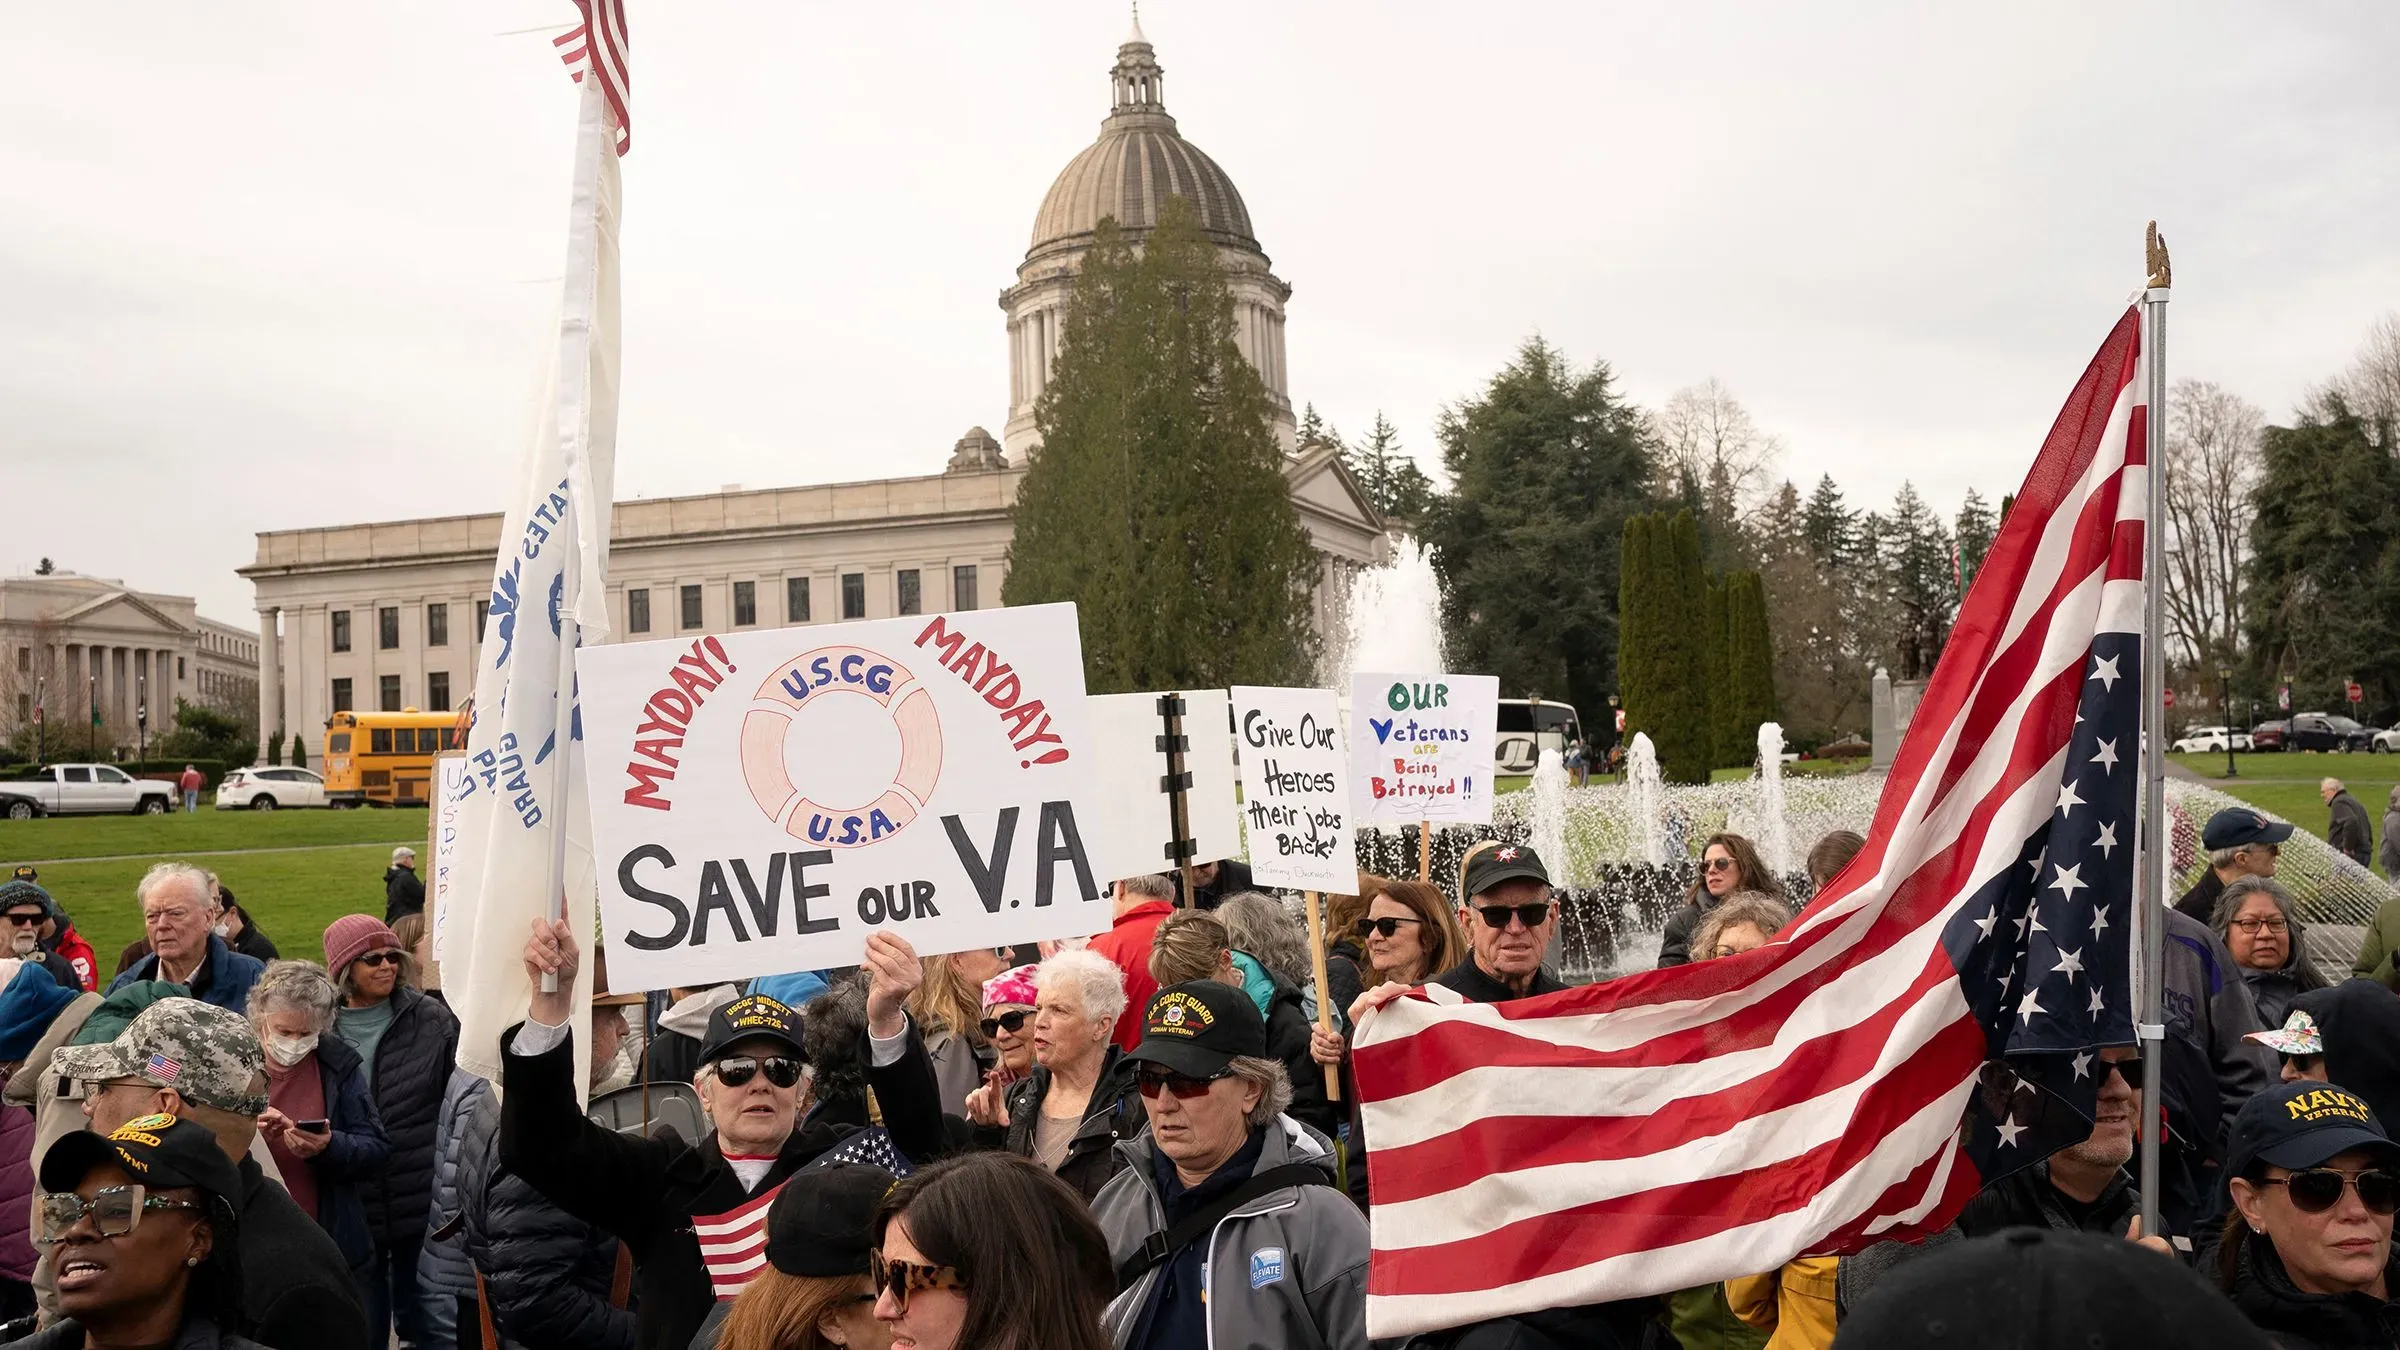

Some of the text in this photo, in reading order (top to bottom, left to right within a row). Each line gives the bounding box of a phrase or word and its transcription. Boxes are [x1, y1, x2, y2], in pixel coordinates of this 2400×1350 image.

[913, 615, 1070, 770] MAYDAY!
[1387, 681, 1449, 712] OUR
[624, 635, 737, 811] MAYDAY!
[1243, 708, 1337, 752] Give Our
[1369, 717, 1470, 745] Veterans
[1413, 742, 1438, 756] are
[1264, 758, 1336, 797] Heroes
[1394, 758, 1438, 778] Being
[1371, 776, 1456, 801] Betrayed
[807, 808, 902, 845] U.S.A.
[1248, 800, 1342, 843] their jobs
[1275, 832, 1337, 860] BACK!
[617, 800, 1111, 951] SAVE OUR V.A.
[726, 995, 792, 1017] USCGC MIDGETT
[1159, 992, 1188, 1007] COAST
[1186, 996, 1214, 1025] GUARD
[739, 1015, 782, 1029] WHEC-726
[1168, 1027, 1194, 1036] VETERAN
[2285, 1089, 2369, 1120] NAVY
[2304, 1108, 2367, 1123] VETERAN
[116, 1146, 149, 1173] ARMY
[1252, 1265, 1281, 1281] ELEVATE
